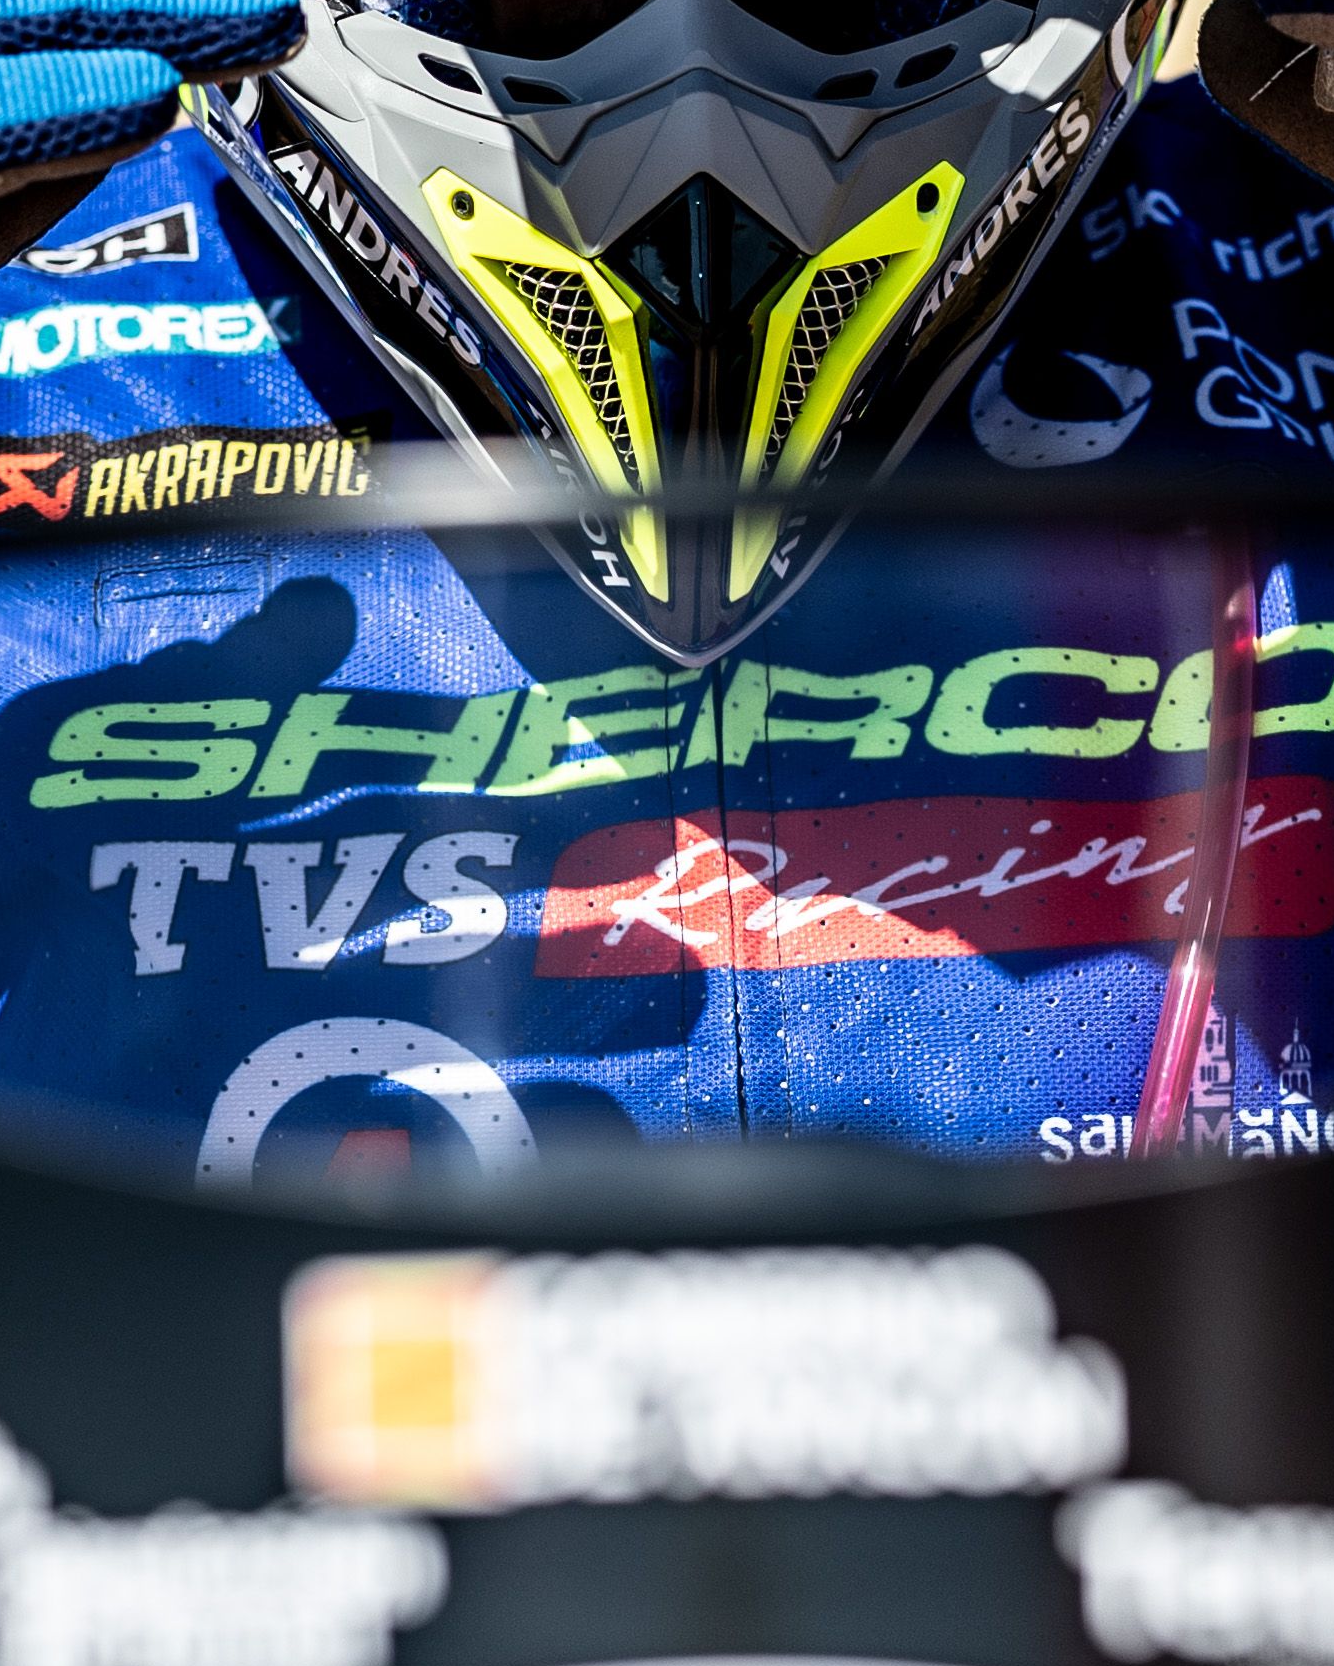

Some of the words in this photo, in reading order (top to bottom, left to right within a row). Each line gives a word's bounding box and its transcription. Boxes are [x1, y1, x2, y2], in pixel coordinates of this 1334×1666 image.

[273, 149, 483, 369] ANDRES
[913, 99, 1090, 333] ANDRES
[89, 831, 520, 976] TVS
[603, 803, 1322, 946] Racing
